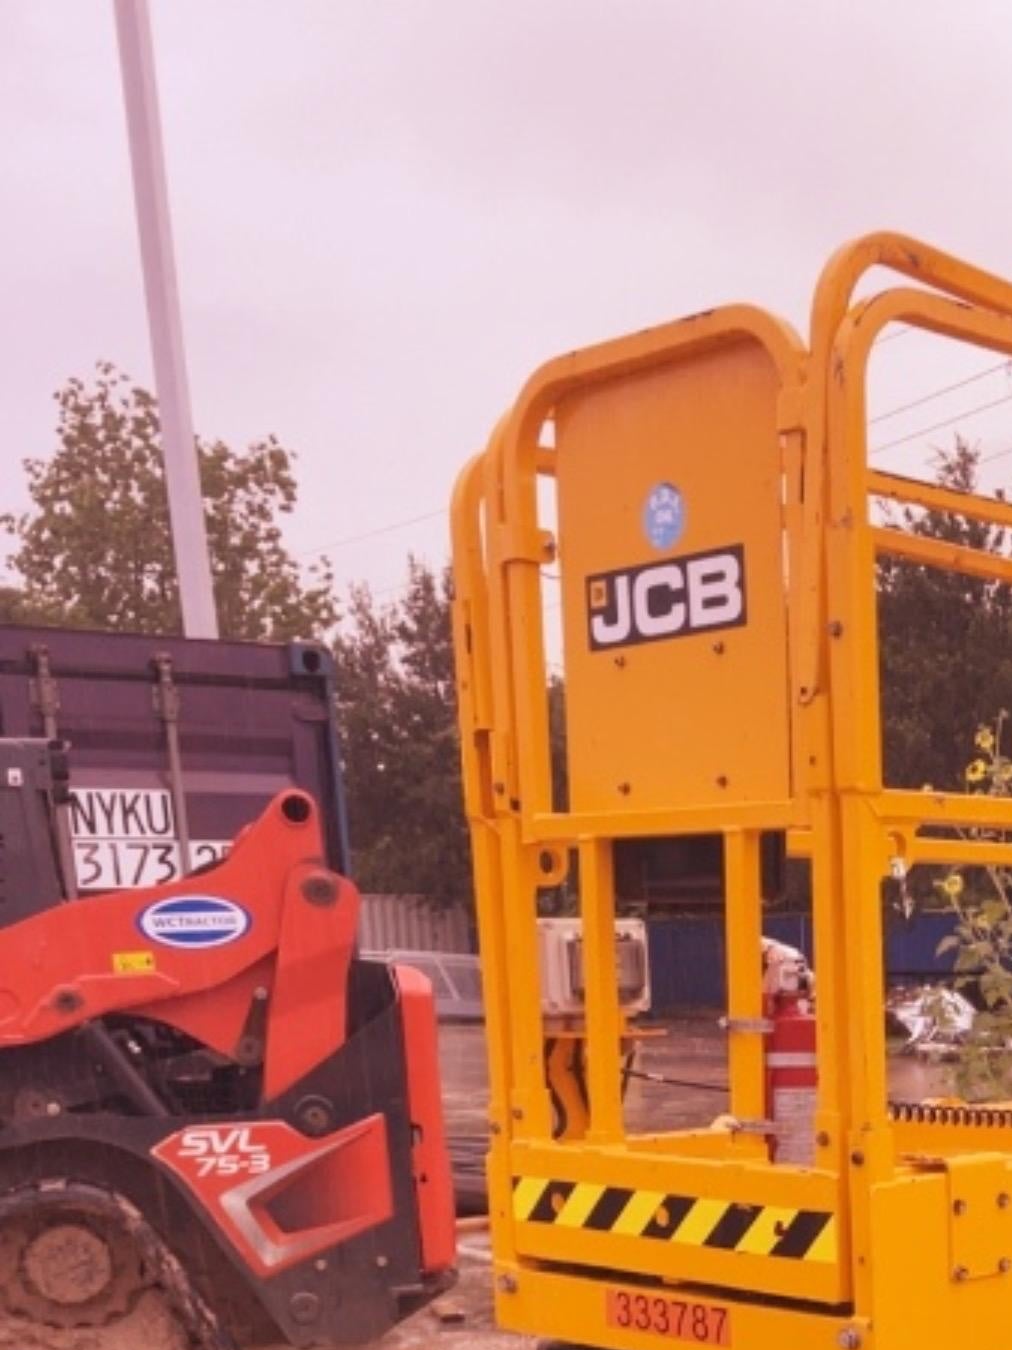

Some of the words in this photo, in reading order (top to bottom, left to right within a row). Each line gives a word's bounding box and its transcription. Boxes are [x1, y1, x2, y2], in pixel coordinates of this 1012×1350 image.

[592, 554, 743, 643] JCB
[71, 791, 172, 836] NYKU
[77, 842, 177, 886] 3173
[177, 1127, 268, 1157] SVL
[194, 1153, 271, 1178] 75-3
[616, 1291, 729, 1345] 333787
